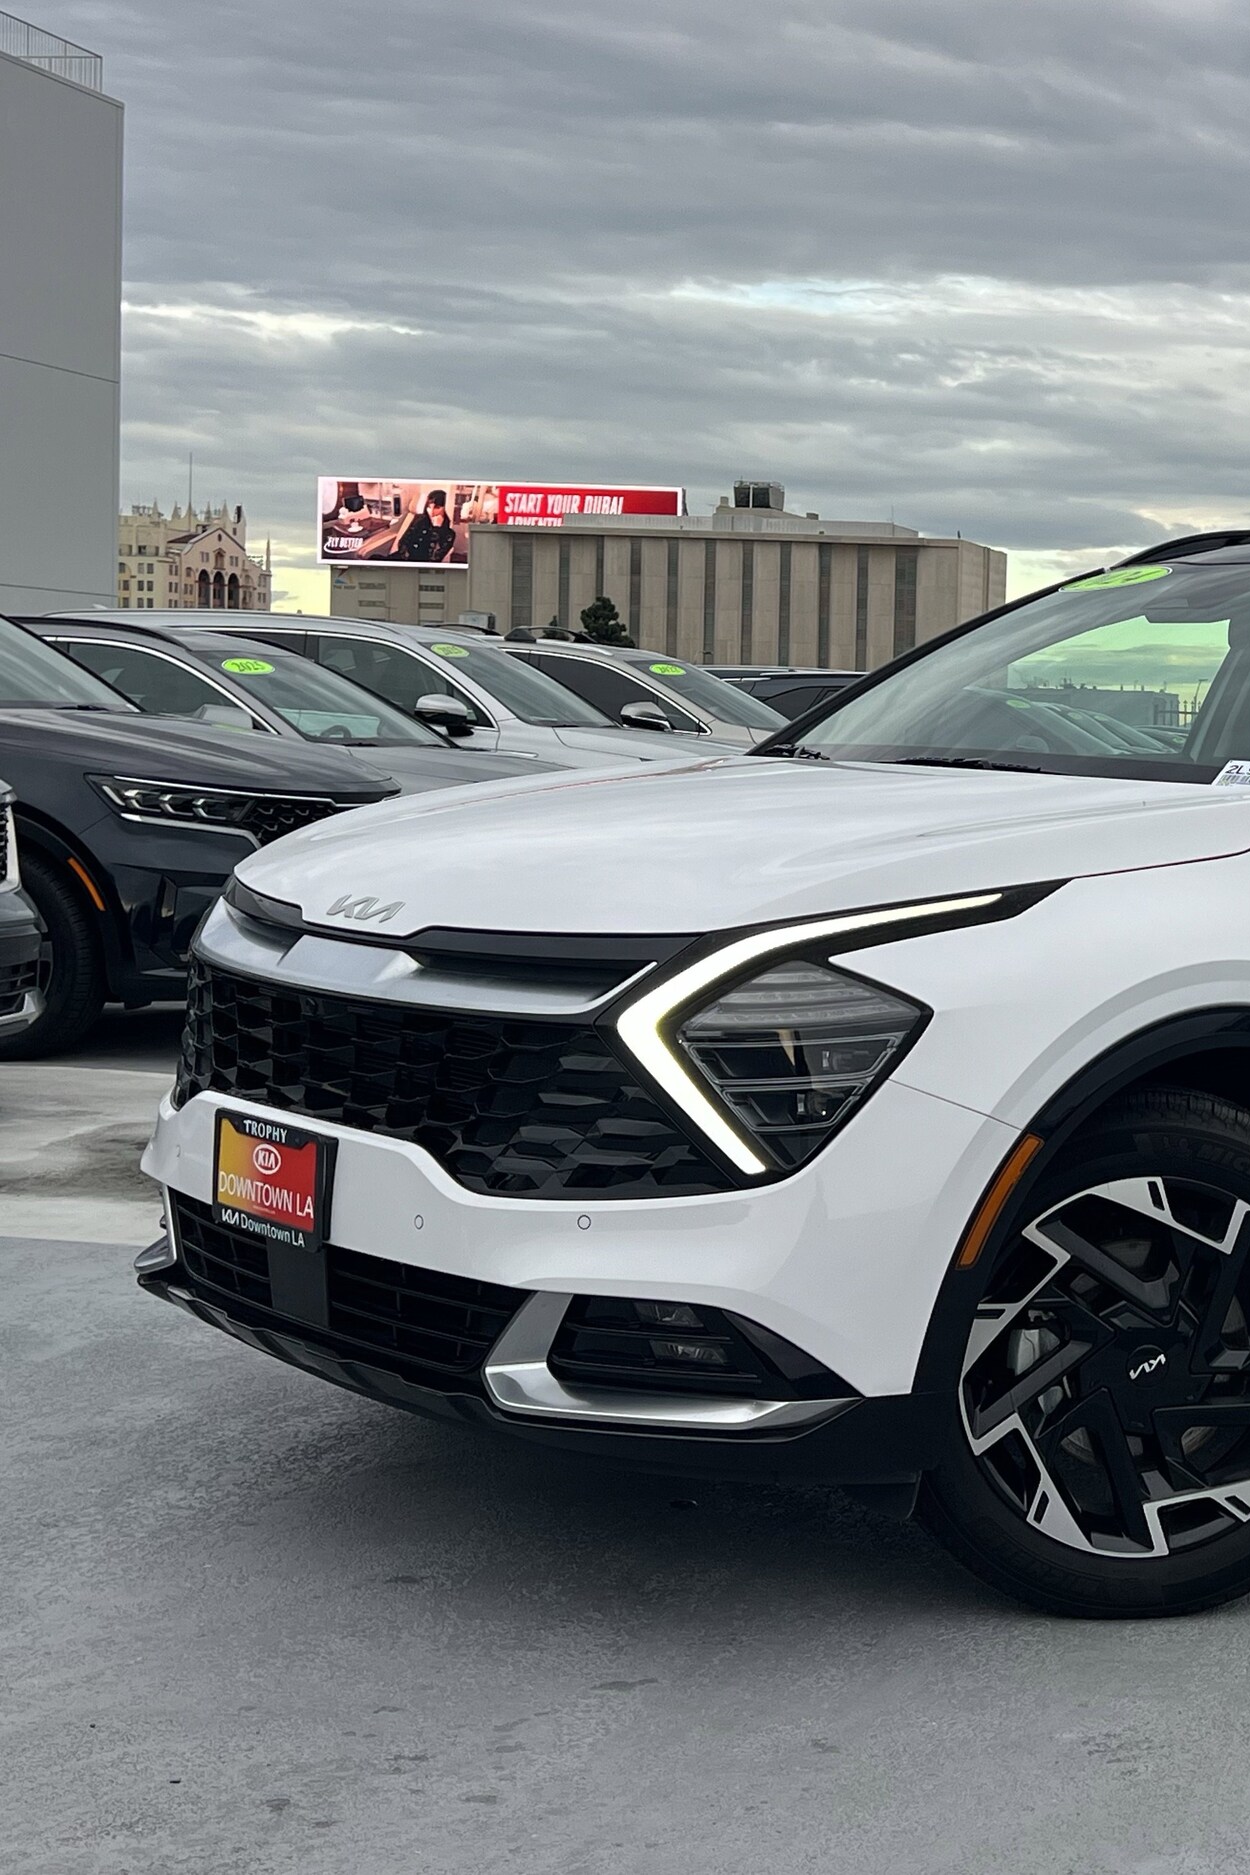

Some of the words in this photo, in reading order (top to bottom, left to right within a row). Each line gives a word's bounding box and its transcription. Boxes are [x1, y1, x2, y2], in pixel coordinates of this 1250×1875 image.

[504, 493, 545, 514] START
[546, 494, 581, 515] YOUR
[583, 495, 625, 515] DUBAI
[327, 536, 339, 548] FLY
[326, 894, 406, 923] KIA
[243, 1119, 287, 1143] TROPHY
[257, 1149, 276, 1169] KIA
[219, 1171, 293, 1213] DOWNTOWN
[296, 1193, 314, 1219] LA
[221, 1208, 239, 1226] KIA
[241, 1214, 290, 1243] Downtown
[291, 1229, 305, 1248] LA
[1129, 1353, 1166, 1380] KIA
